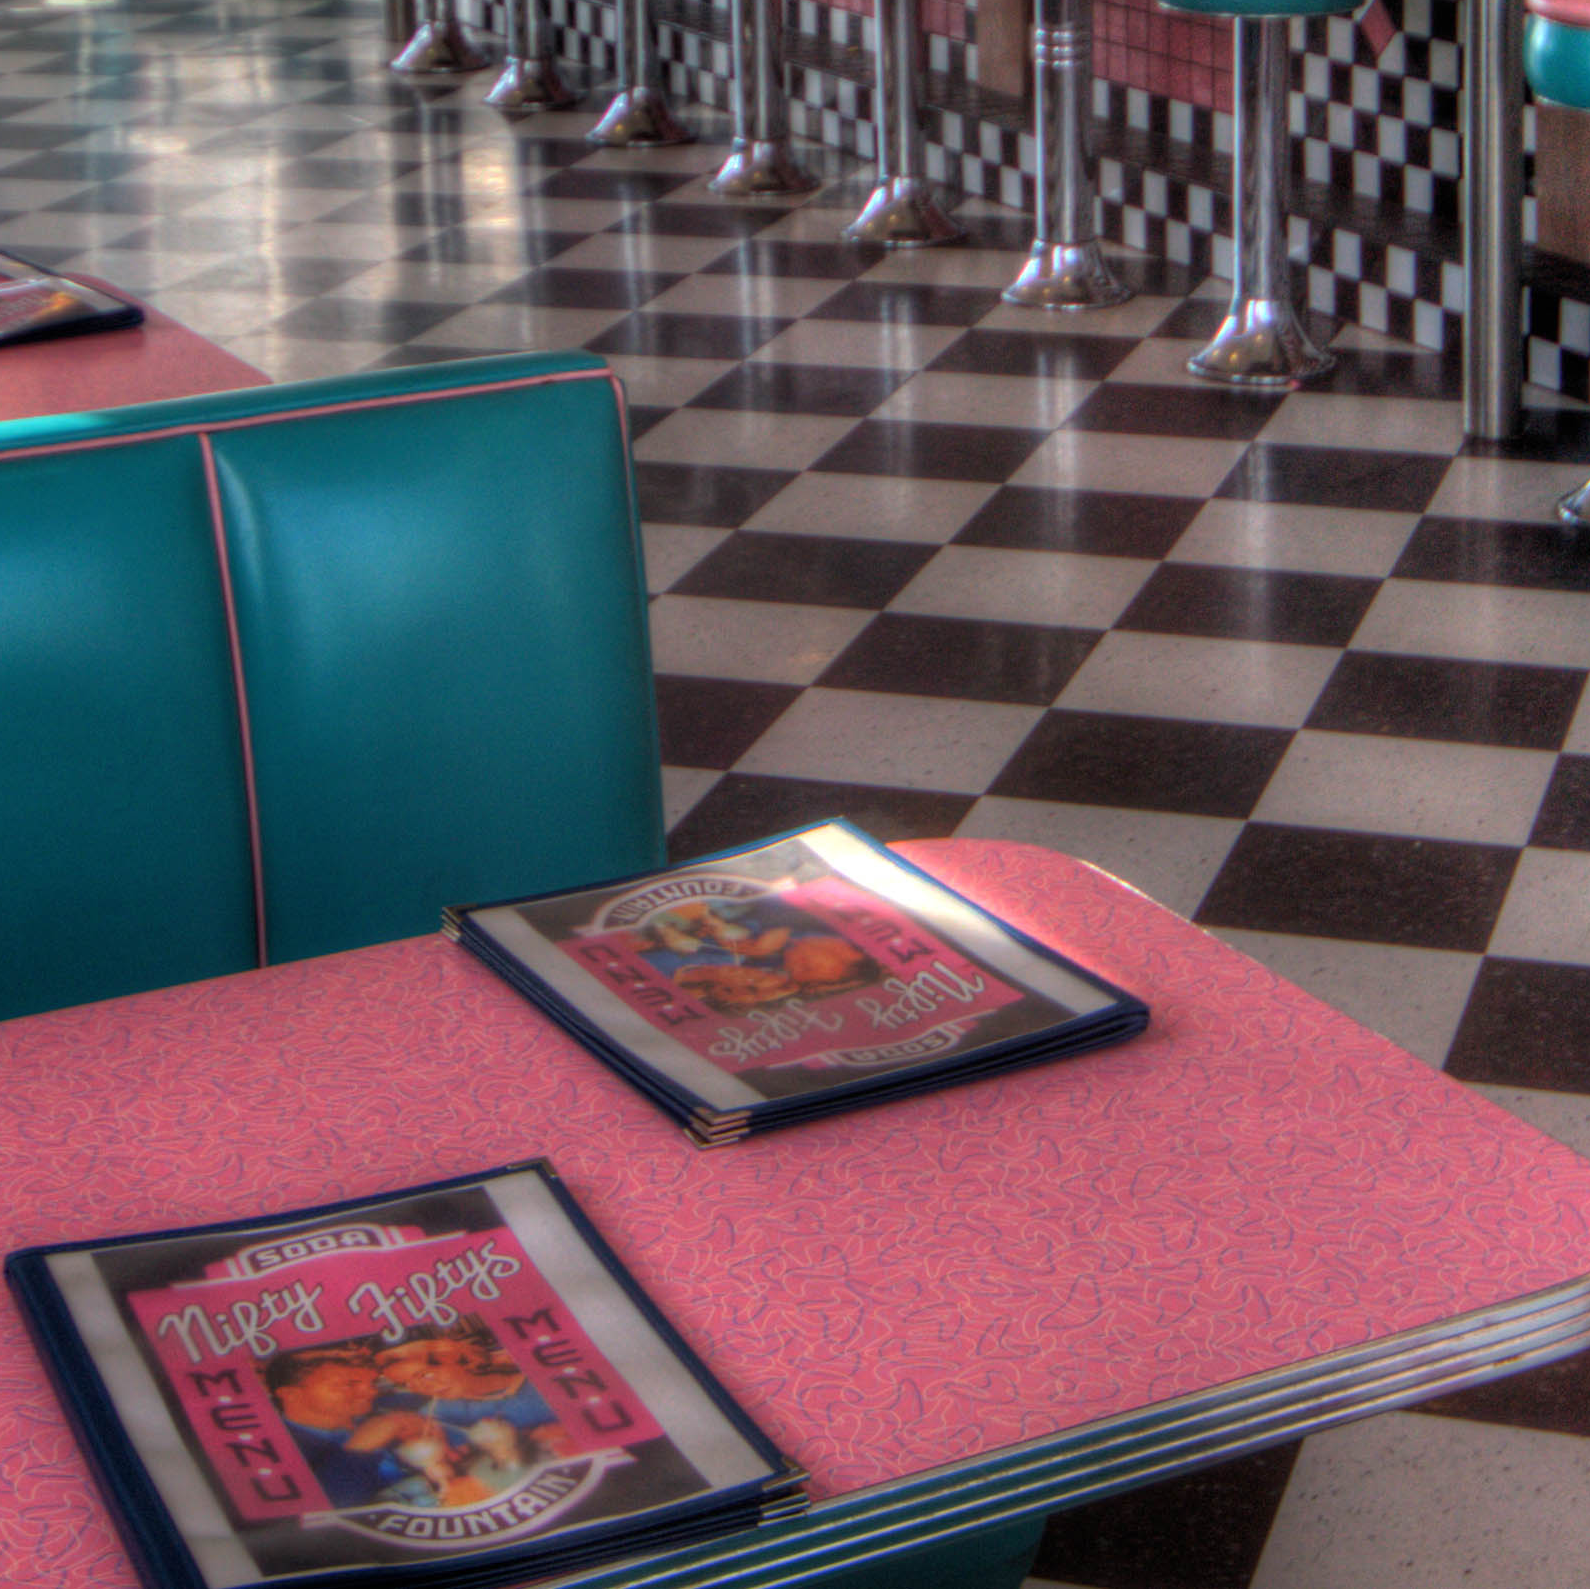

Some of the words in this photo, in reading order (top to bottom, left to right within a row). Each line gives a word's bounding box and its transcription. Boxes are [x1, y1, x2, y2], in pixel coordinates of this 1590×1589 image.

[854, 960, 986, 1030] Nifty
[708, 997, 845, 1064] Fiftys
[255, 1229, 371, 1268] SODA
[157, 1278, 330, 1364] Nifty
[347, 1239, 522, 1343] Fiftys
[377, 1472, 577, 1540] FOUNTAIN
